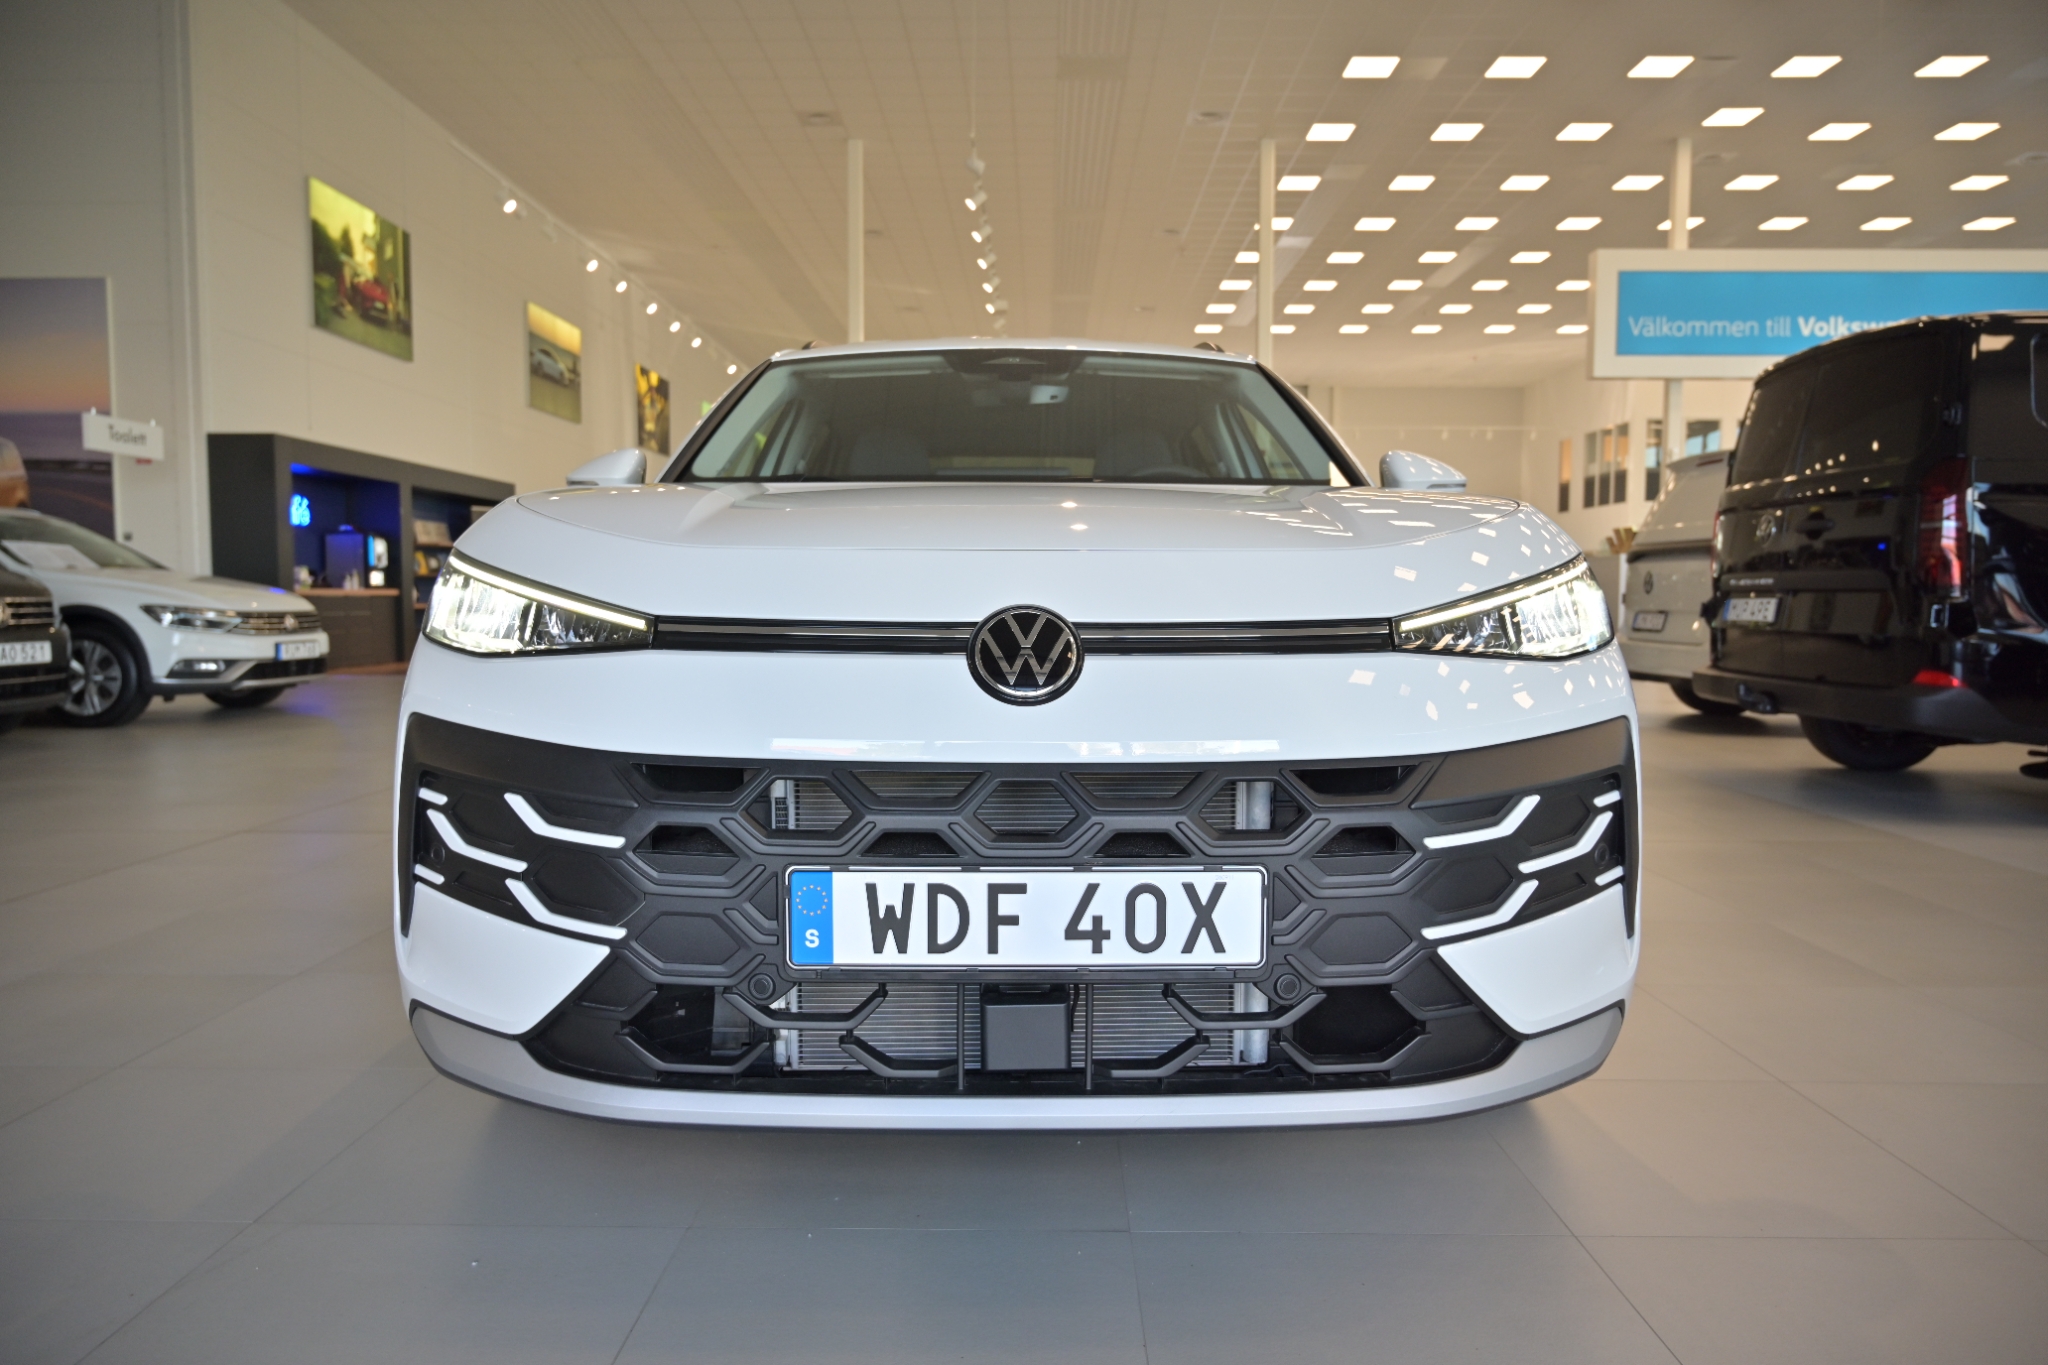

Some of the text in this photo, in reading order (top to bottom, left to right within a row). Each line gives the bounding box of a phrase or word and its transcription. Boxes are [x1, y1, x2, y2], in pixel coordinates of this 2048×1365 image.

[1629, 315, 1759, 338] Välkommen
[1766, 315, 1792, 337] till
[20, 642, 46, 661] 521
[865, 882, 1228, 954] WDF 40X
[804, 928, 820, 949] S
